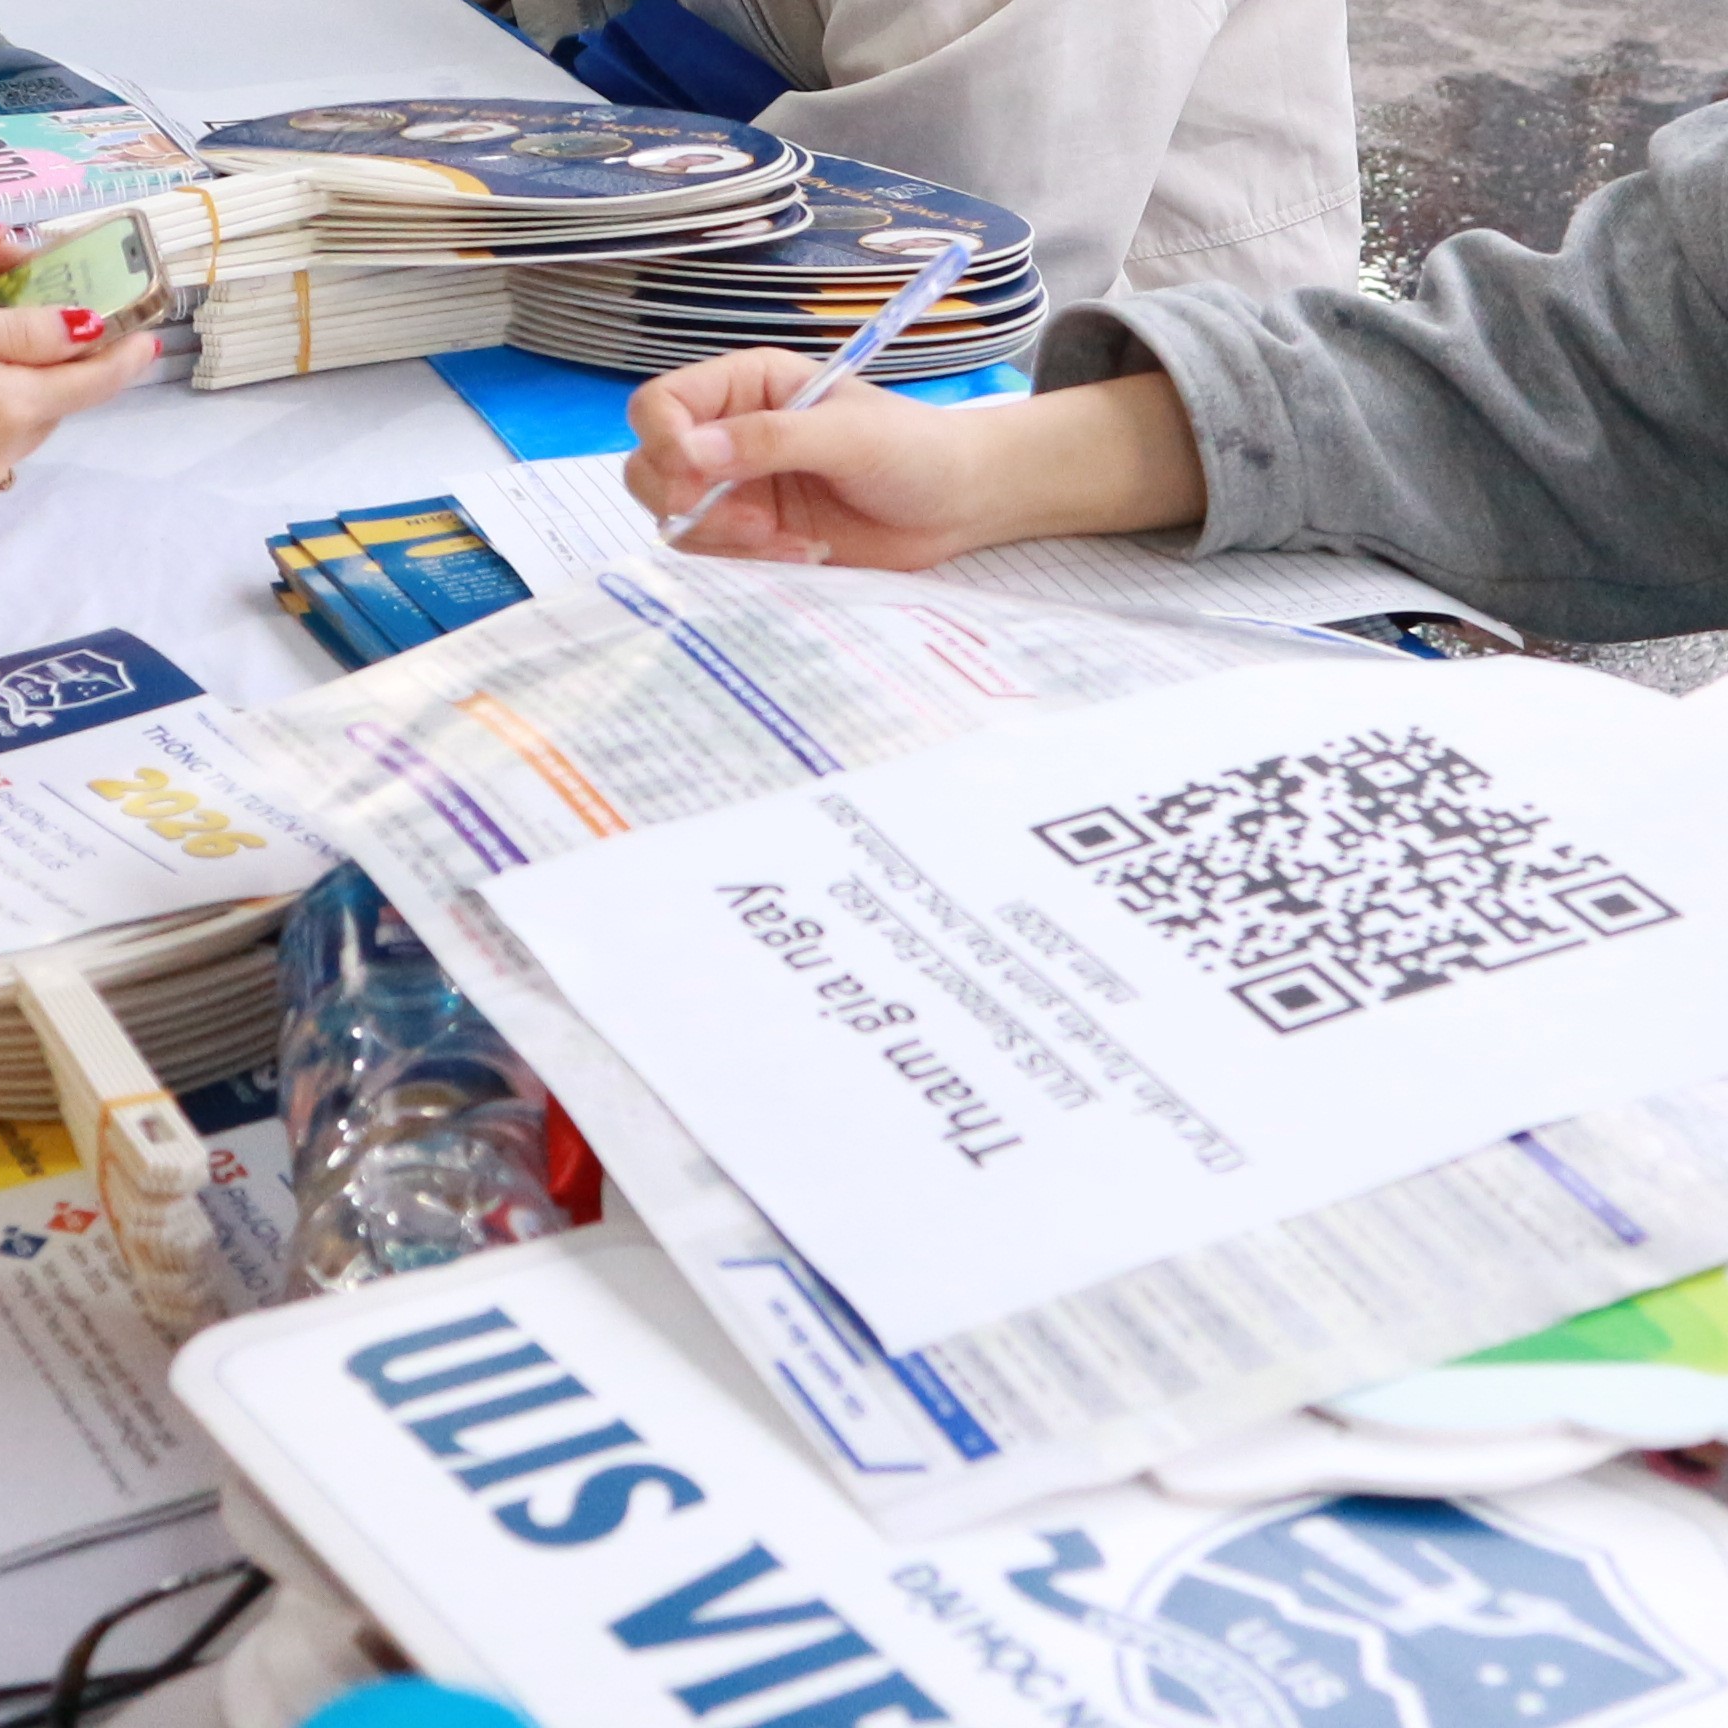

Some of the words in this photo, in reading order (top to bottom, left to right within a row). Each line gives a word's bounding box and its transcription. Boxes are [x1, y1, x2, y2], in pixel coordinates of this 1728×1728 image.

[142, 723, 213, 775] THÔNG
[86, 766, 268, 859] 2026
[714, 881, 835, 971] ngay
[816, 973, 917, 1035] gia
[883, 1038, 1025, 1169] Tham
[344, 1305, 707, 1551] ULIS
